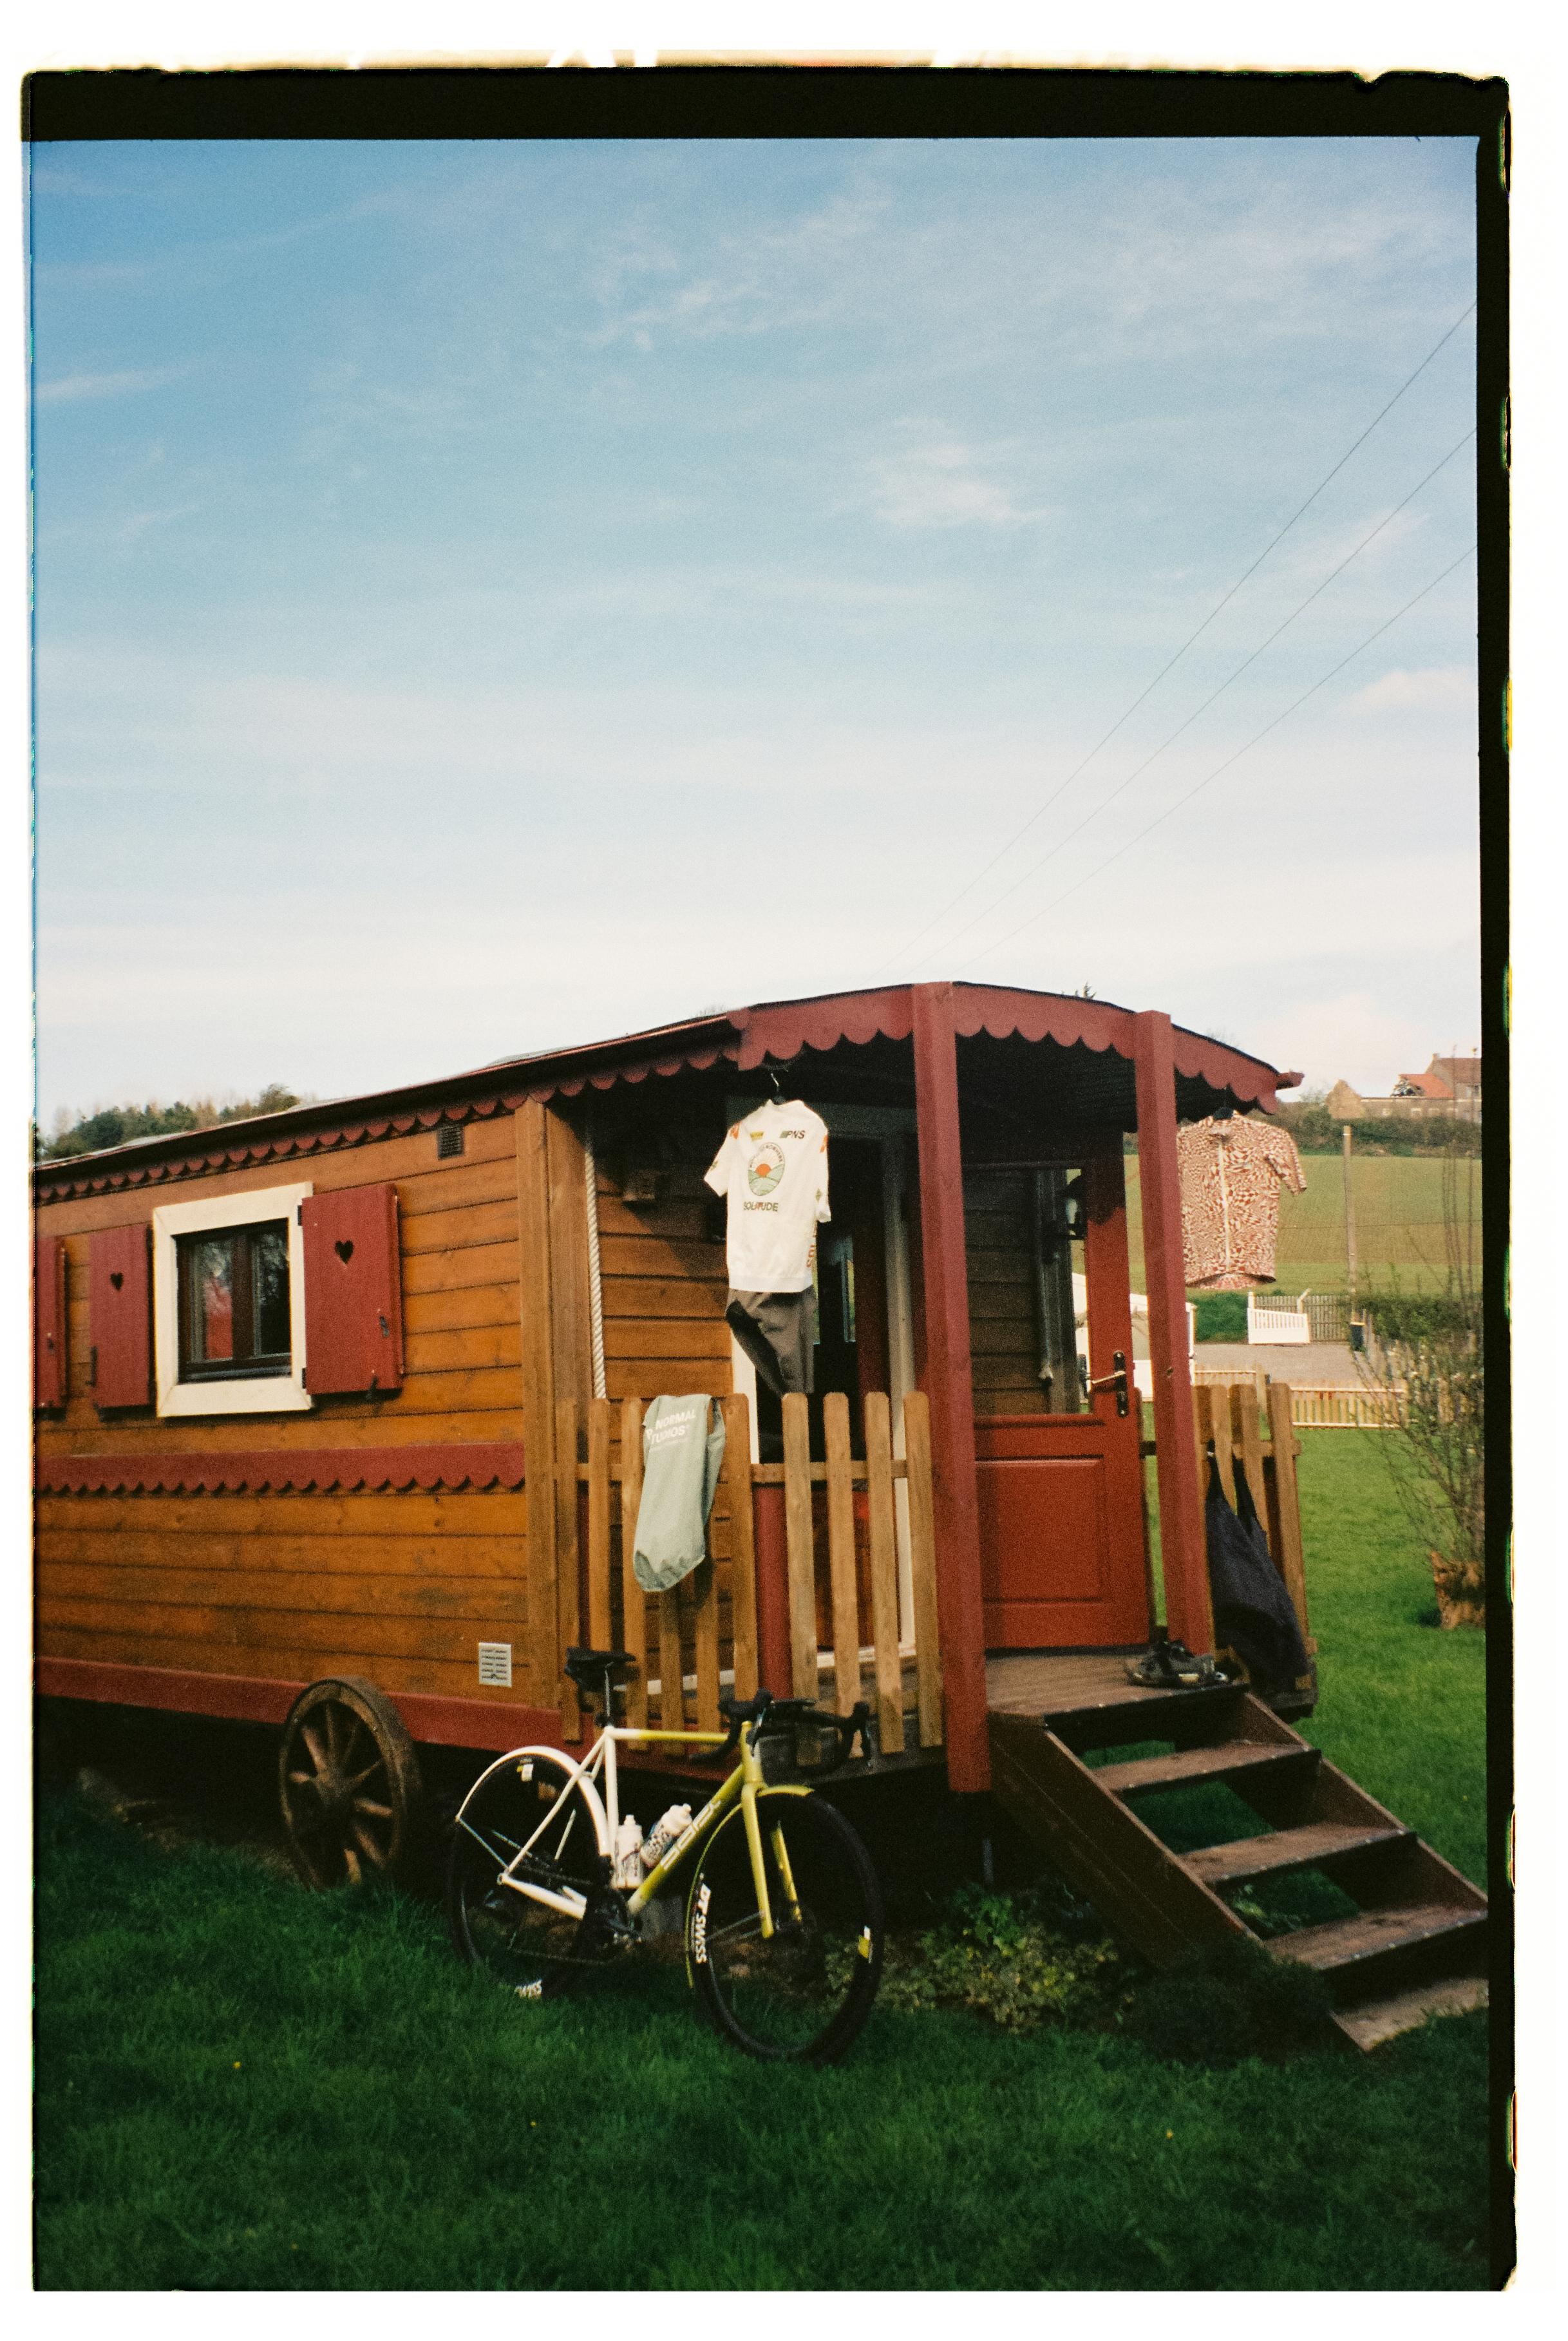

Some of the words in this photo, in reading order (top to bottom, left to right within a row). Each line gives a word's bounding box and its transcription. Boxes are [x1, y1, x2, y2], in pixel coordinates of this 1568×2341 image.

[786, 1130, 806, 1139] PNS
[743, 1201, 779, 1211] SOLITUDE
[656, 1409, 695, 1429] NORMAL
[649, 1425, 686, 1444] TUDIOS
[695, 1913, 707, 1964] SWISS
